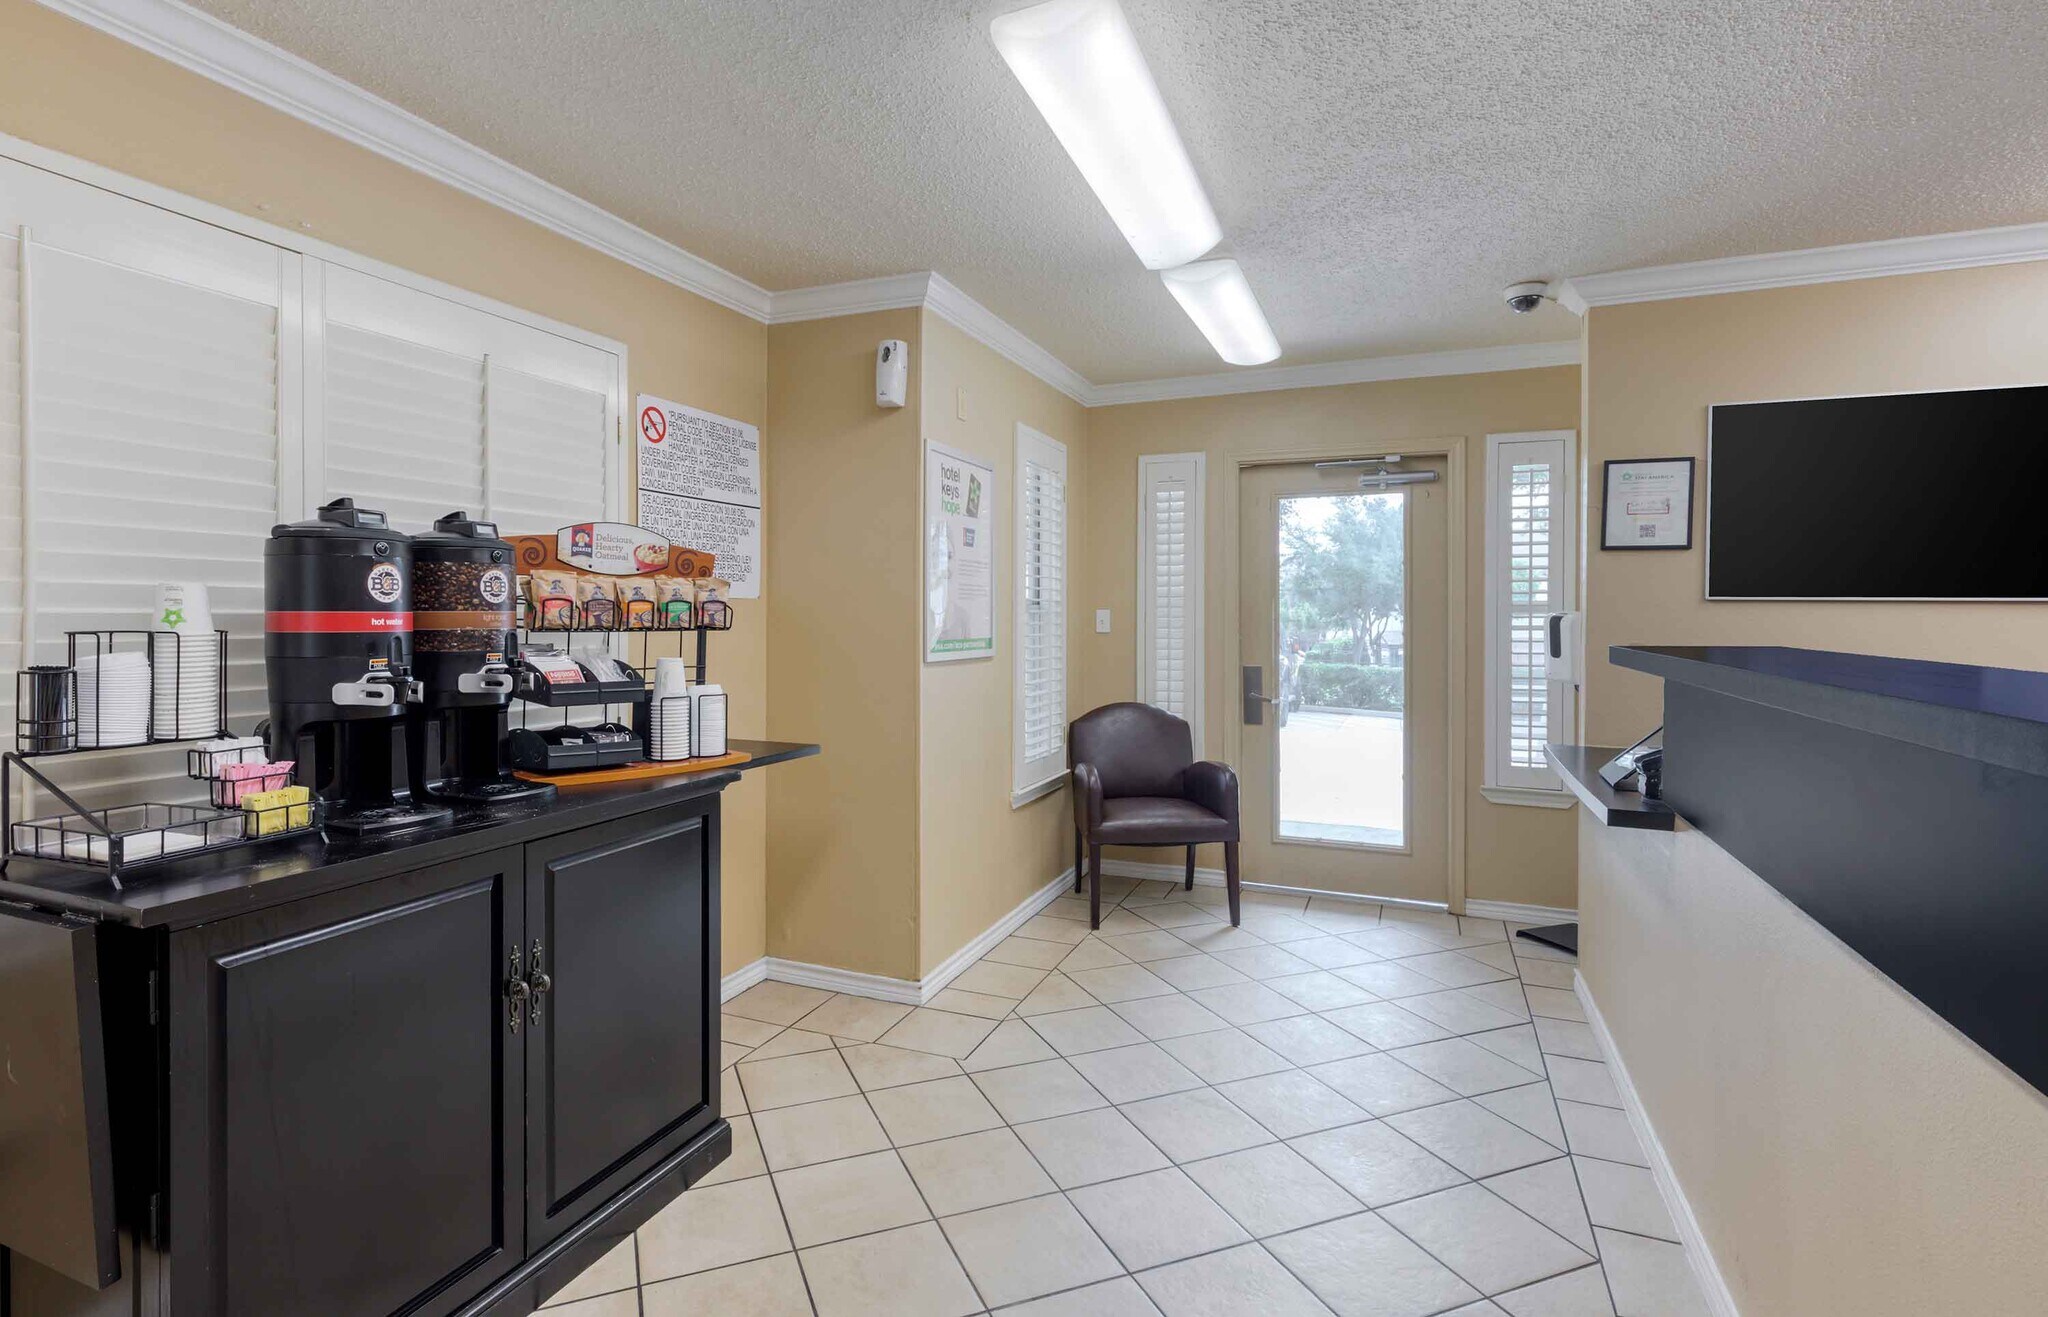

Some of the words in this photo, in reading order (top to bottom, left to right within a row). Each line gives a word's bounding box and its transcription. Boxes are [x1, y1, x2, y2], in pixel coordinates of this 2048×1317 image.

[668, 420, 686, 433] PENAL
[687, 425, 702, 437] CODE
[731, 437, 738, 446] BY
[738, 439, 756, 451] LICENSE
[700, 419, 708, 429] TO
[709, 421, 730, 434] SECTION
[668, 431, 690, 444] HOLDER
[691, 436, 705, 448] WITH
[705, 440, 709, 449] A
[710, 441, 740, 456] CONCEALED
[641, 445, 659, 458] UNDER
[661, 450, 698, 466] SUBCHAPTER
[705, 459, 728, 472] CHAPTER
[699, 448, 702, 457] A
[703, 449, 724, 462] PERSON
[725, 454, 748, 467] LICENSED
[641, 456, 680, 472] GOVERNMENT
[681, 464, 696, 475] CODE
[725, 473, 750, 486] LICENSING
[941, 463, 960, 482] hotel
[641, 477, 675, 492] CONCEALED
[657, 470, 669, 481] MAY
[670, 472, 681, 483] NOT
[683, 475, 700, 486] ENTER
[701, 478, 713, 488] THIS
[714, 481, 740, 493] PROPERTY
[741, 486, 753, 495] WITH
[753, 488, 758, 496] A
[942, 481, 960, 500] keys
[651, 495, 679, 508] ACUERDO
[680, 500, 692, 510] CON
[692, 501, 700, 511] LA
[737, 508, 746, 517] DEL
[942, 498, 960, 516] hope
[665, 508, 682, 519] PENAL
[710, 514, 718, 523] SIN
[641, 515, 649, 525] DE
[650, 516, 658, 526] UN
[659, 517, 682, 528] TITULAR
[683, 520, 691, 529] DE
[692, 521, 702, 531] UNA
[703, 523, 726, 534] LICENCIA
[727, 526, 738, 535] CON
[739, 527, 749, 536] UNA
[595, 533, 634, 544] Delicious,
[690, 531, 701, 540] UNA
[702, 532, 726, 543] PERSONA
[727, 535, 738, 544] CON
[594, 551, 629, 561] Oatmeal
[595, 542, 624, 553] Hearty
[371, 576, 400, 591] B&B
[483, 580, 507, 593] B&B
[371, 617, 385, 626] hot
[386, 618, 403, 626] water
